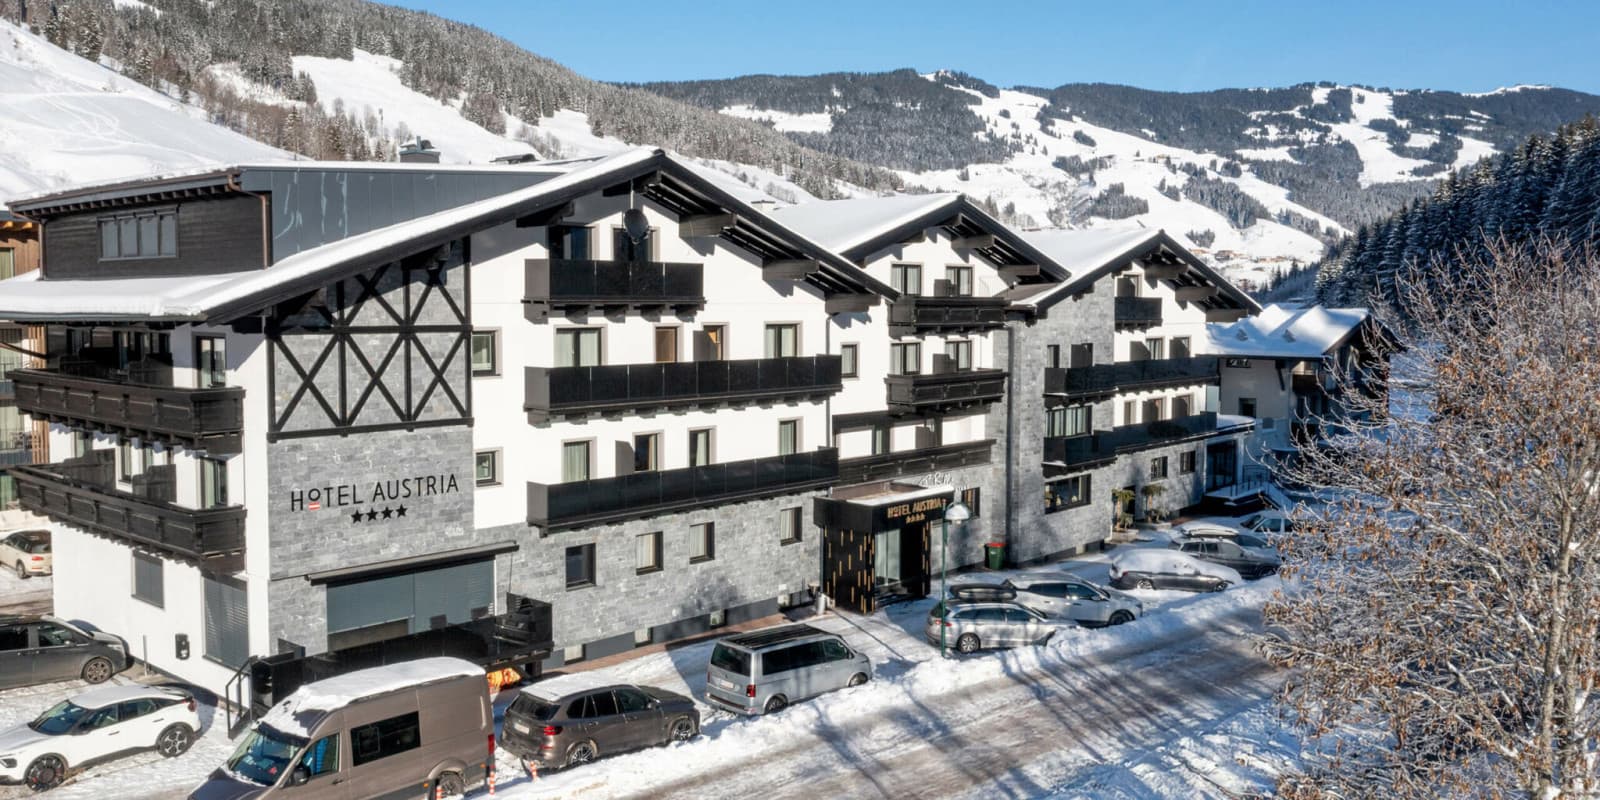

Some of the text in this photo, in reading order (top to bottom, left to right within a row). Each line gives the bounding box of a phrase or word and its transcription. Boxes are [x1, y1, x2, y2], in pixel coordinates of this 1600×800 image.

[291, 474, 459, 512] HOTEL AUSTRIA
[887, 498, 942, 518] HOTEL AUSTRIA
